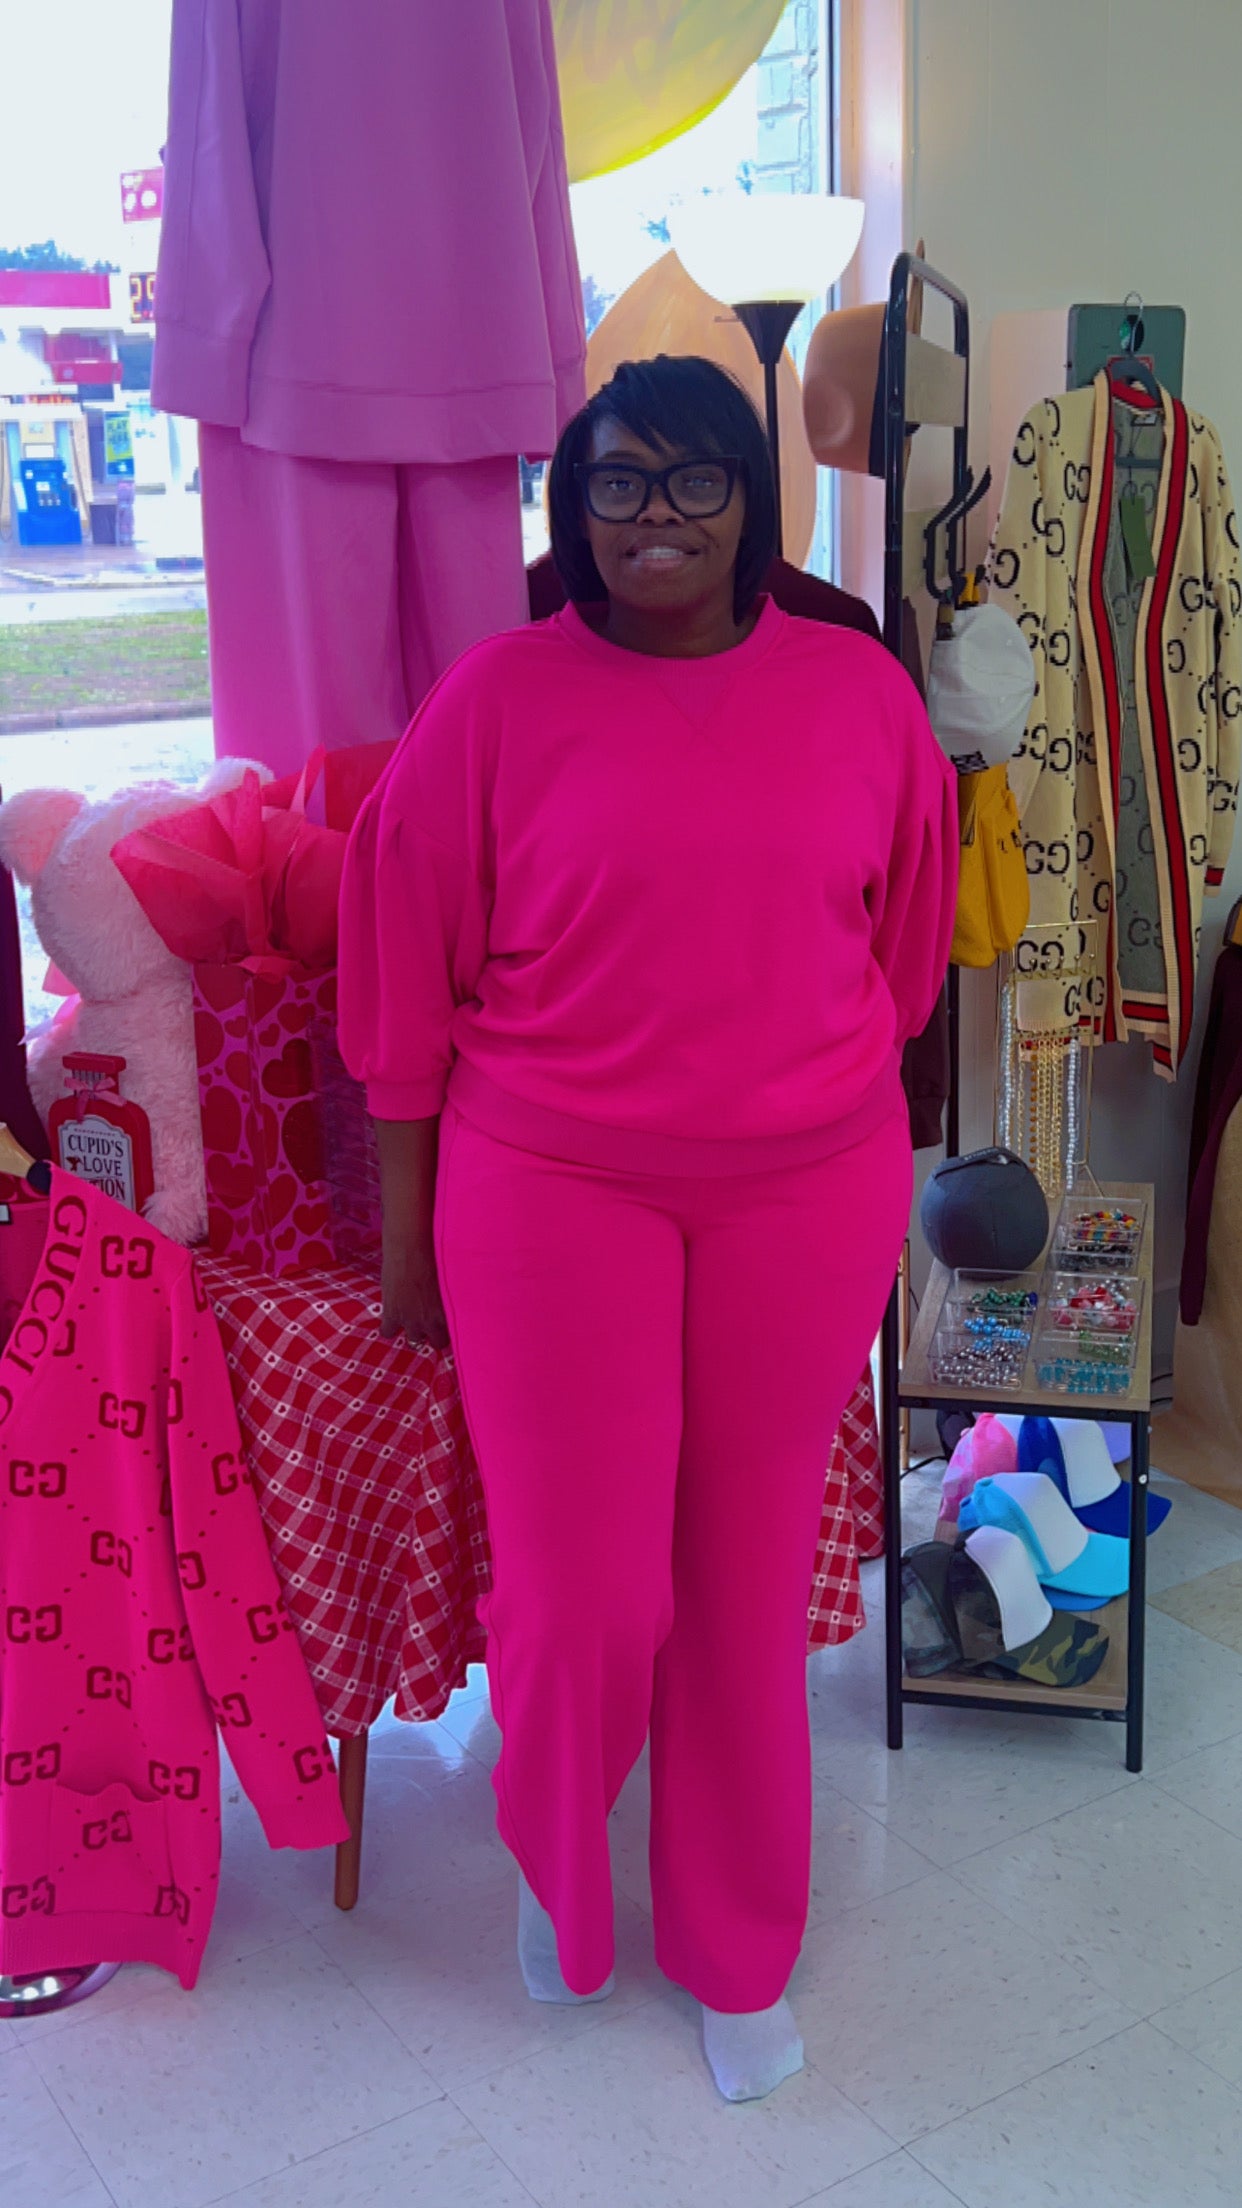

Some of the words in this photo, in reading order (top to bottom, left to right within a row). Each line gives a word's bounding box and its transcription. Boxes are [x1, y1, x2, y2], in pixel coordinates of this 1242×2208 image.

[68, 1134, 124, 1158] CUPID'S
[83, 1155, 123, 1177] LOVE
[5, 1194, 88, 1375] GUCCI
